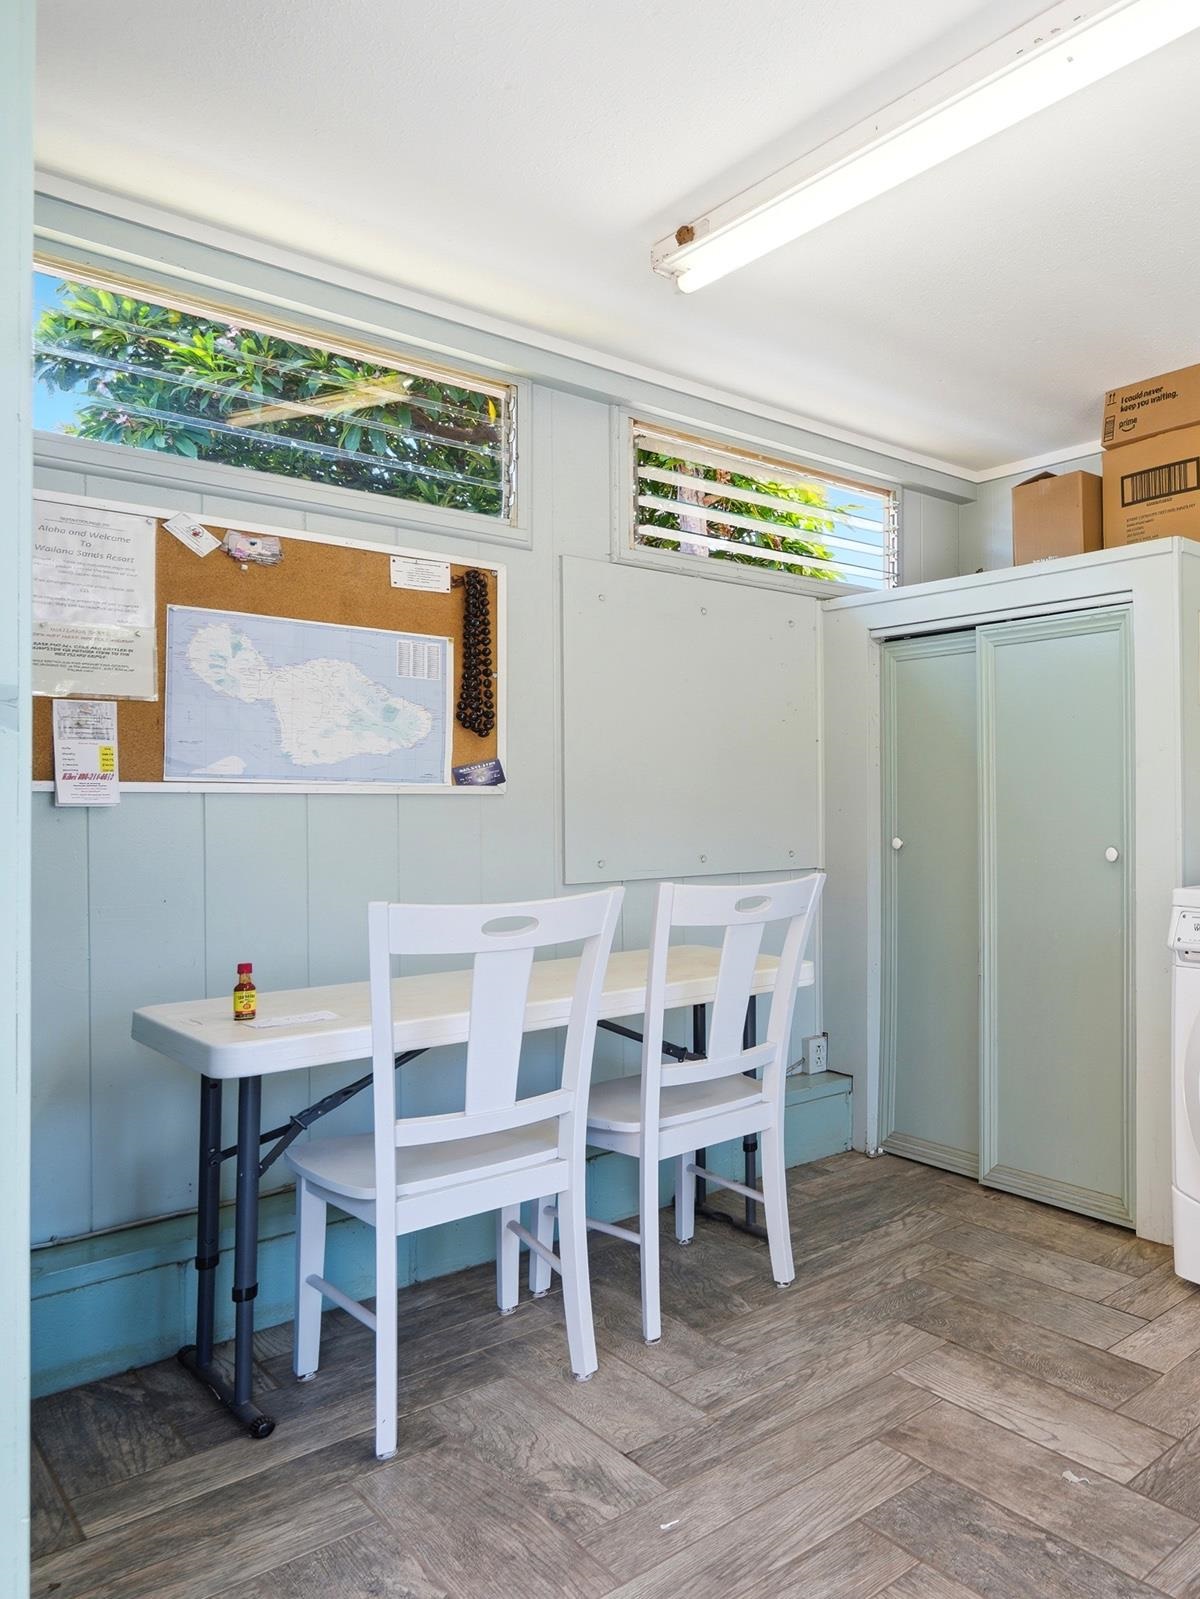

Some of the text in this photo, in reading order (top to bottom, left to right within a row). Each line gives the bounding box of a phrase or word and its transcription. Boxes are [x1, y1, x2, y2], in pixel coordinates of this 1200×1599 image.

[1120, 391, 1178, 412] keep you waiting.
[1125, 386, 1164, 403] could never
[1119, 417, 1138, 430] prime
[38, 524, 132, 544] Aloha and Welcome
[34, 543, 135, 563] Wailana Sands Resort
